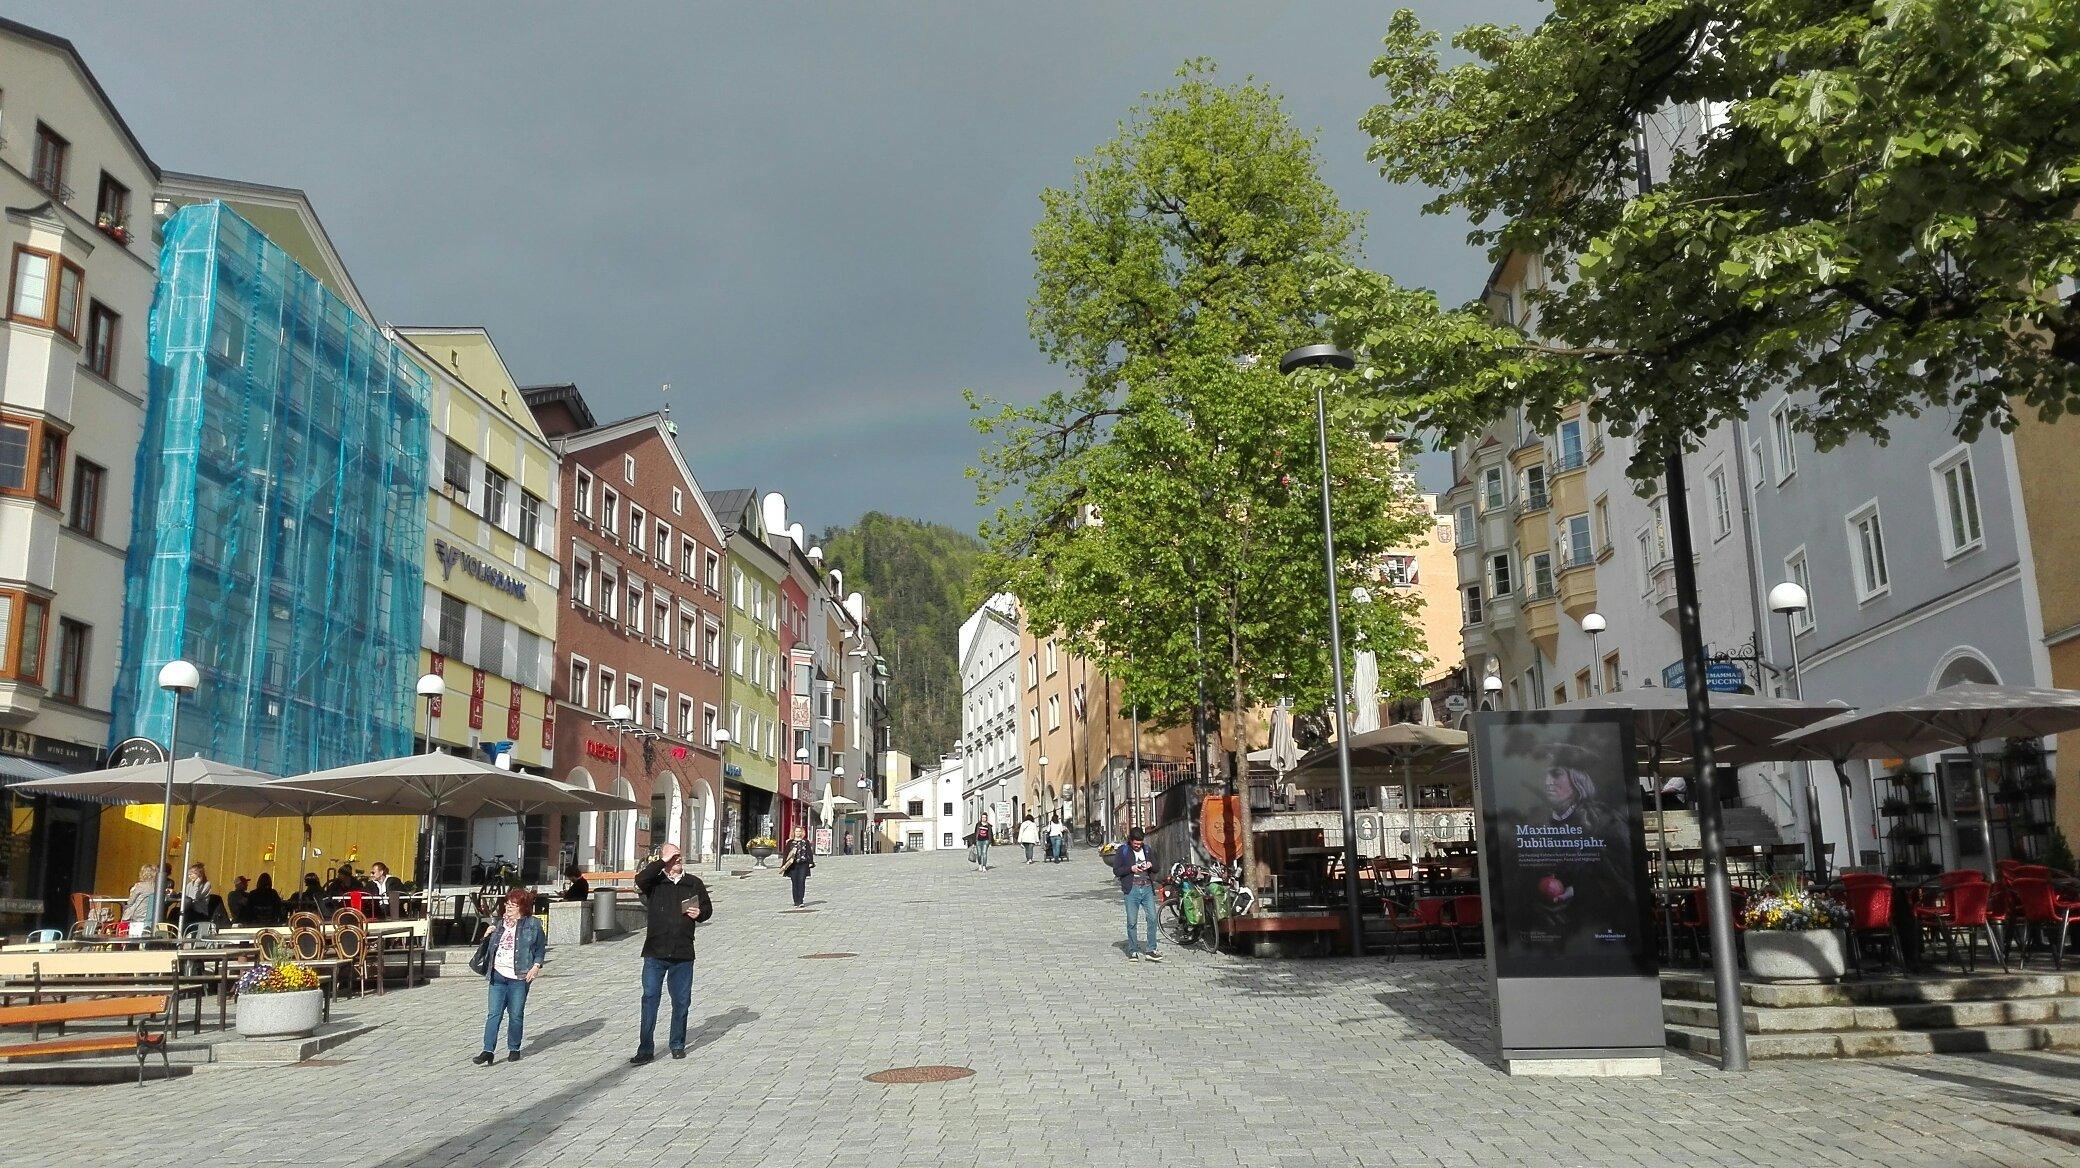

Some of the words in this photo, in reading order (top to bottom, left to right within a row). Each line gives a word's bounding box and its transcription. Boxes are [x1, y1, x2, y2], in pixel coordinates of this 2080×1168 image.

[460, 551, 527, 602] VOLKSBANK
[47, 746, 64, 755] WINE
[66, 749, 78, 758] BAR
[1516, 824, 1583, 835] Maximales
[1517, 837, 1607, 849] Jubiläumsjahr.
